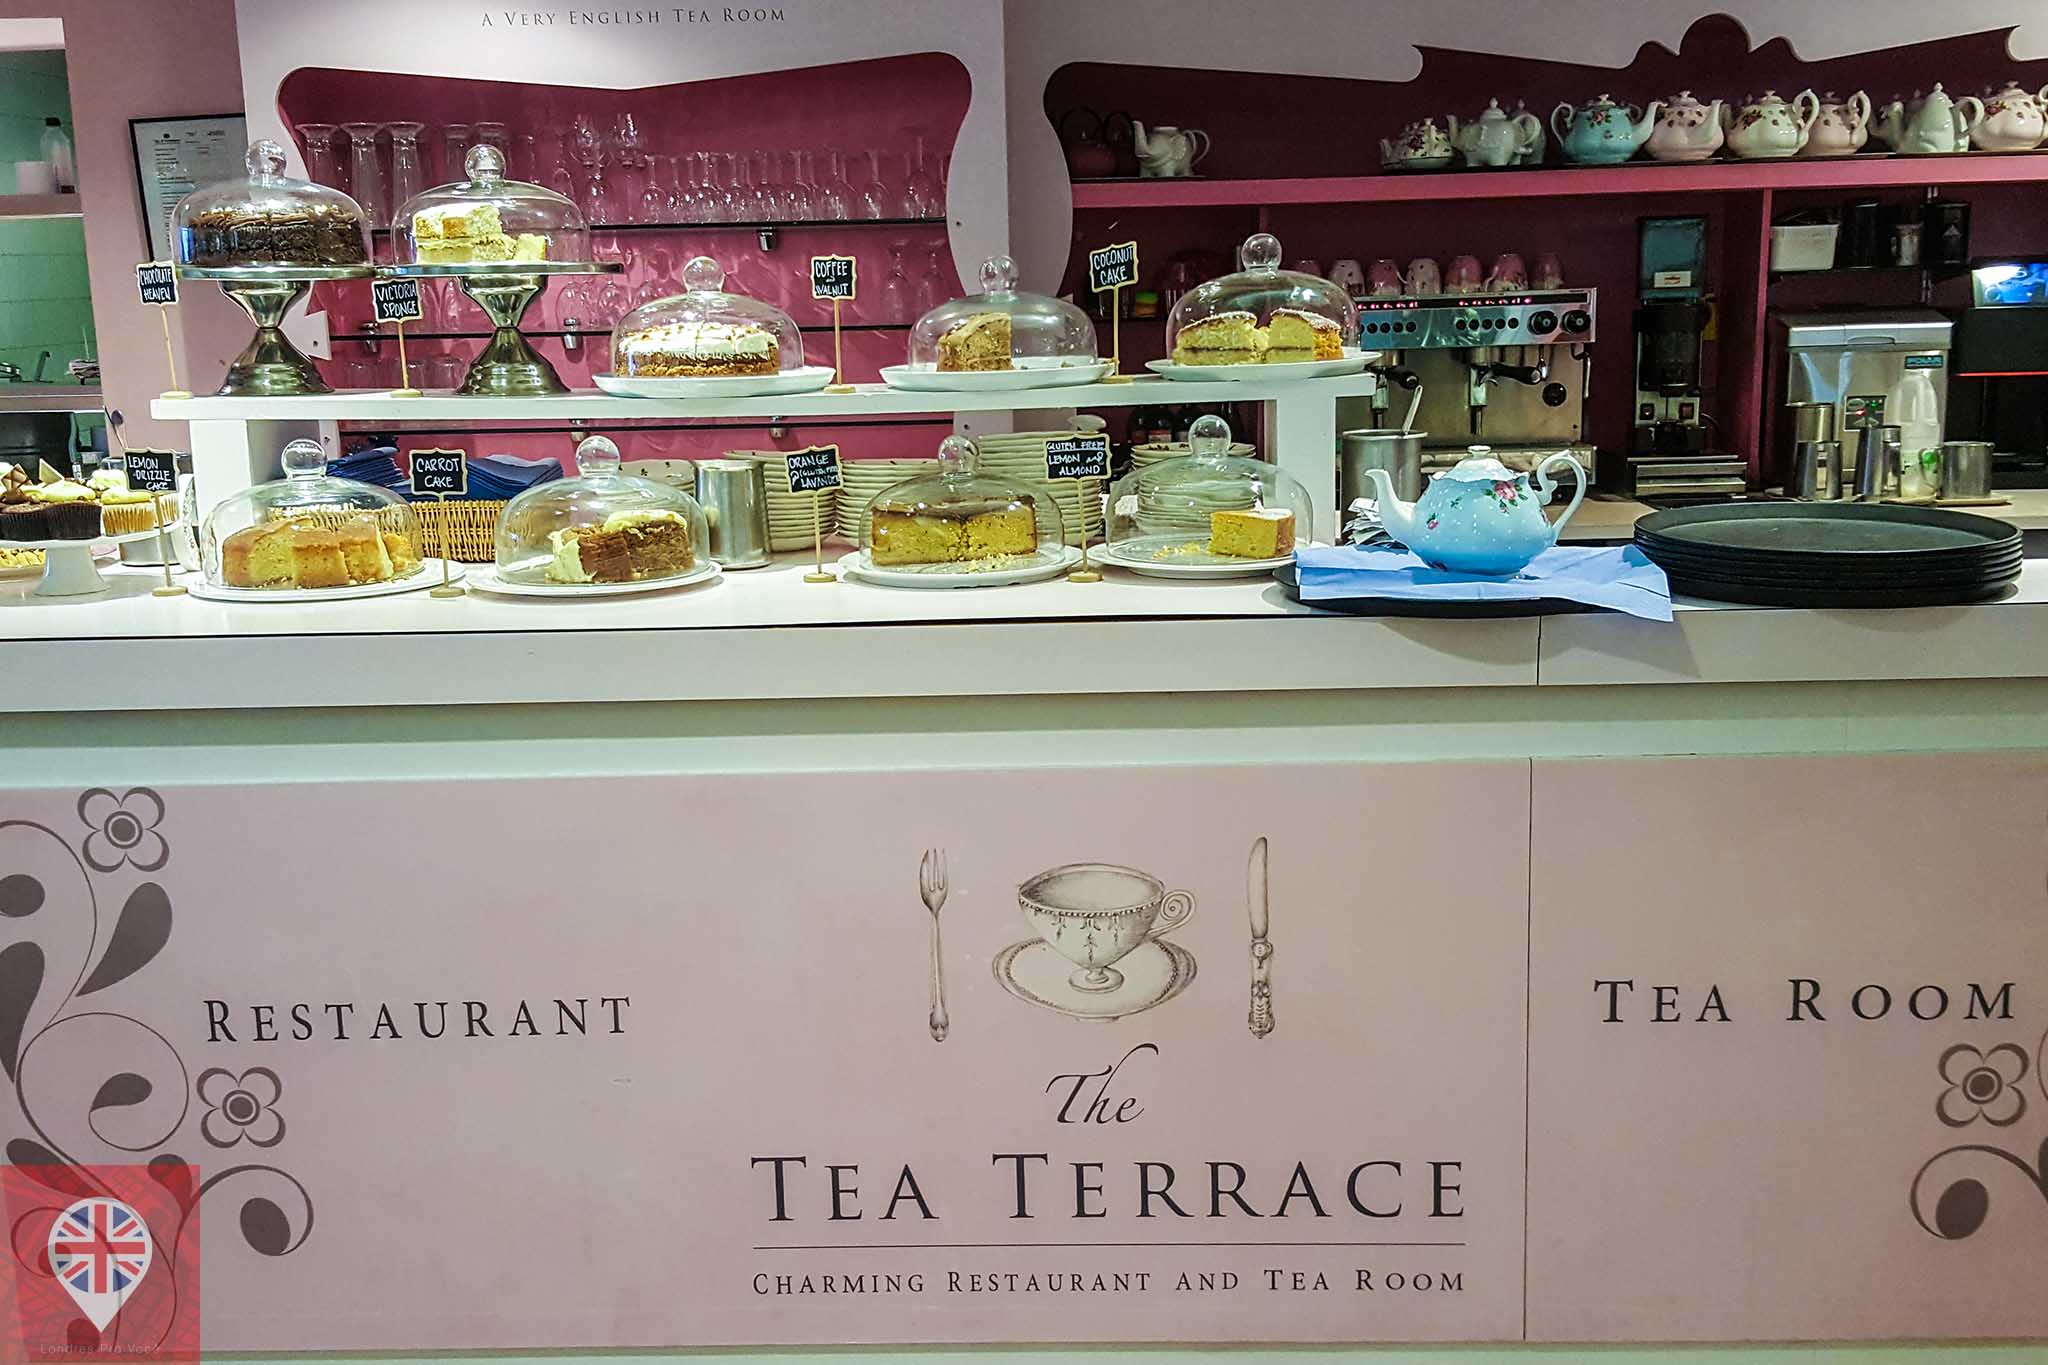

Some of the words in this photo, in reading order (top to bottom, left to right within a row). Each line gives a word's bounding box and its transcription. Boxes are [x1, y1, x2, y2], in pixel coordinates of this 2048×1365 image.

[481, 13, 493, 26] A
[504, 11, 556, 26] VERY
[569, 9, 660, 25] ENGLISH
[672, 8, 710, 23] TEA
[723, 7, 784, 22] ROOM
[1093, 246, 1133, 270] COCONUT
[139, 268, 172, 286] CHOCOLATE
[815, 261, 848, 278] COFFEE
[1100, 265, 1128, 285] CAKE
[143, 287, 171, 301] HEAVEN
[376, 283, 417, 301] VICTORIA
[814, 283, 849, 297] WALNUT
[383, 301, 418, 317] SPONGE
[127, 456, 159, 470] LEMON
[416, 458, 460, 473] CARROT
[788, 454, 829, 469] ORANGE
[1048, 454, 1080, 465] LEMON
[1059, 466, 1101, 476] ALMOND
[145, 481, 169, 491] CAKE
[424, 475, 454, 488] CAKE
[1593, 978, 1732, 1023] TEA
[1786, 977, 2016, 1023] ROOM
[206, 996, 631, 1042] RESTAURANT
[1044, 1043, 1159, 1125] The
[750, 1154, 940, 1222] TEA
[991, 1152, 1465, 1219] TERRACE
[752, 1271, 925, 1296] CHARMING
[947, 1270, 1151, 1294] RESTAURANT
[1175, 1271, 1239, 1293] AND
[1263, 1269, 1331, 1292] TEA
[1355, 1269, 1465, 1292] ROOM
